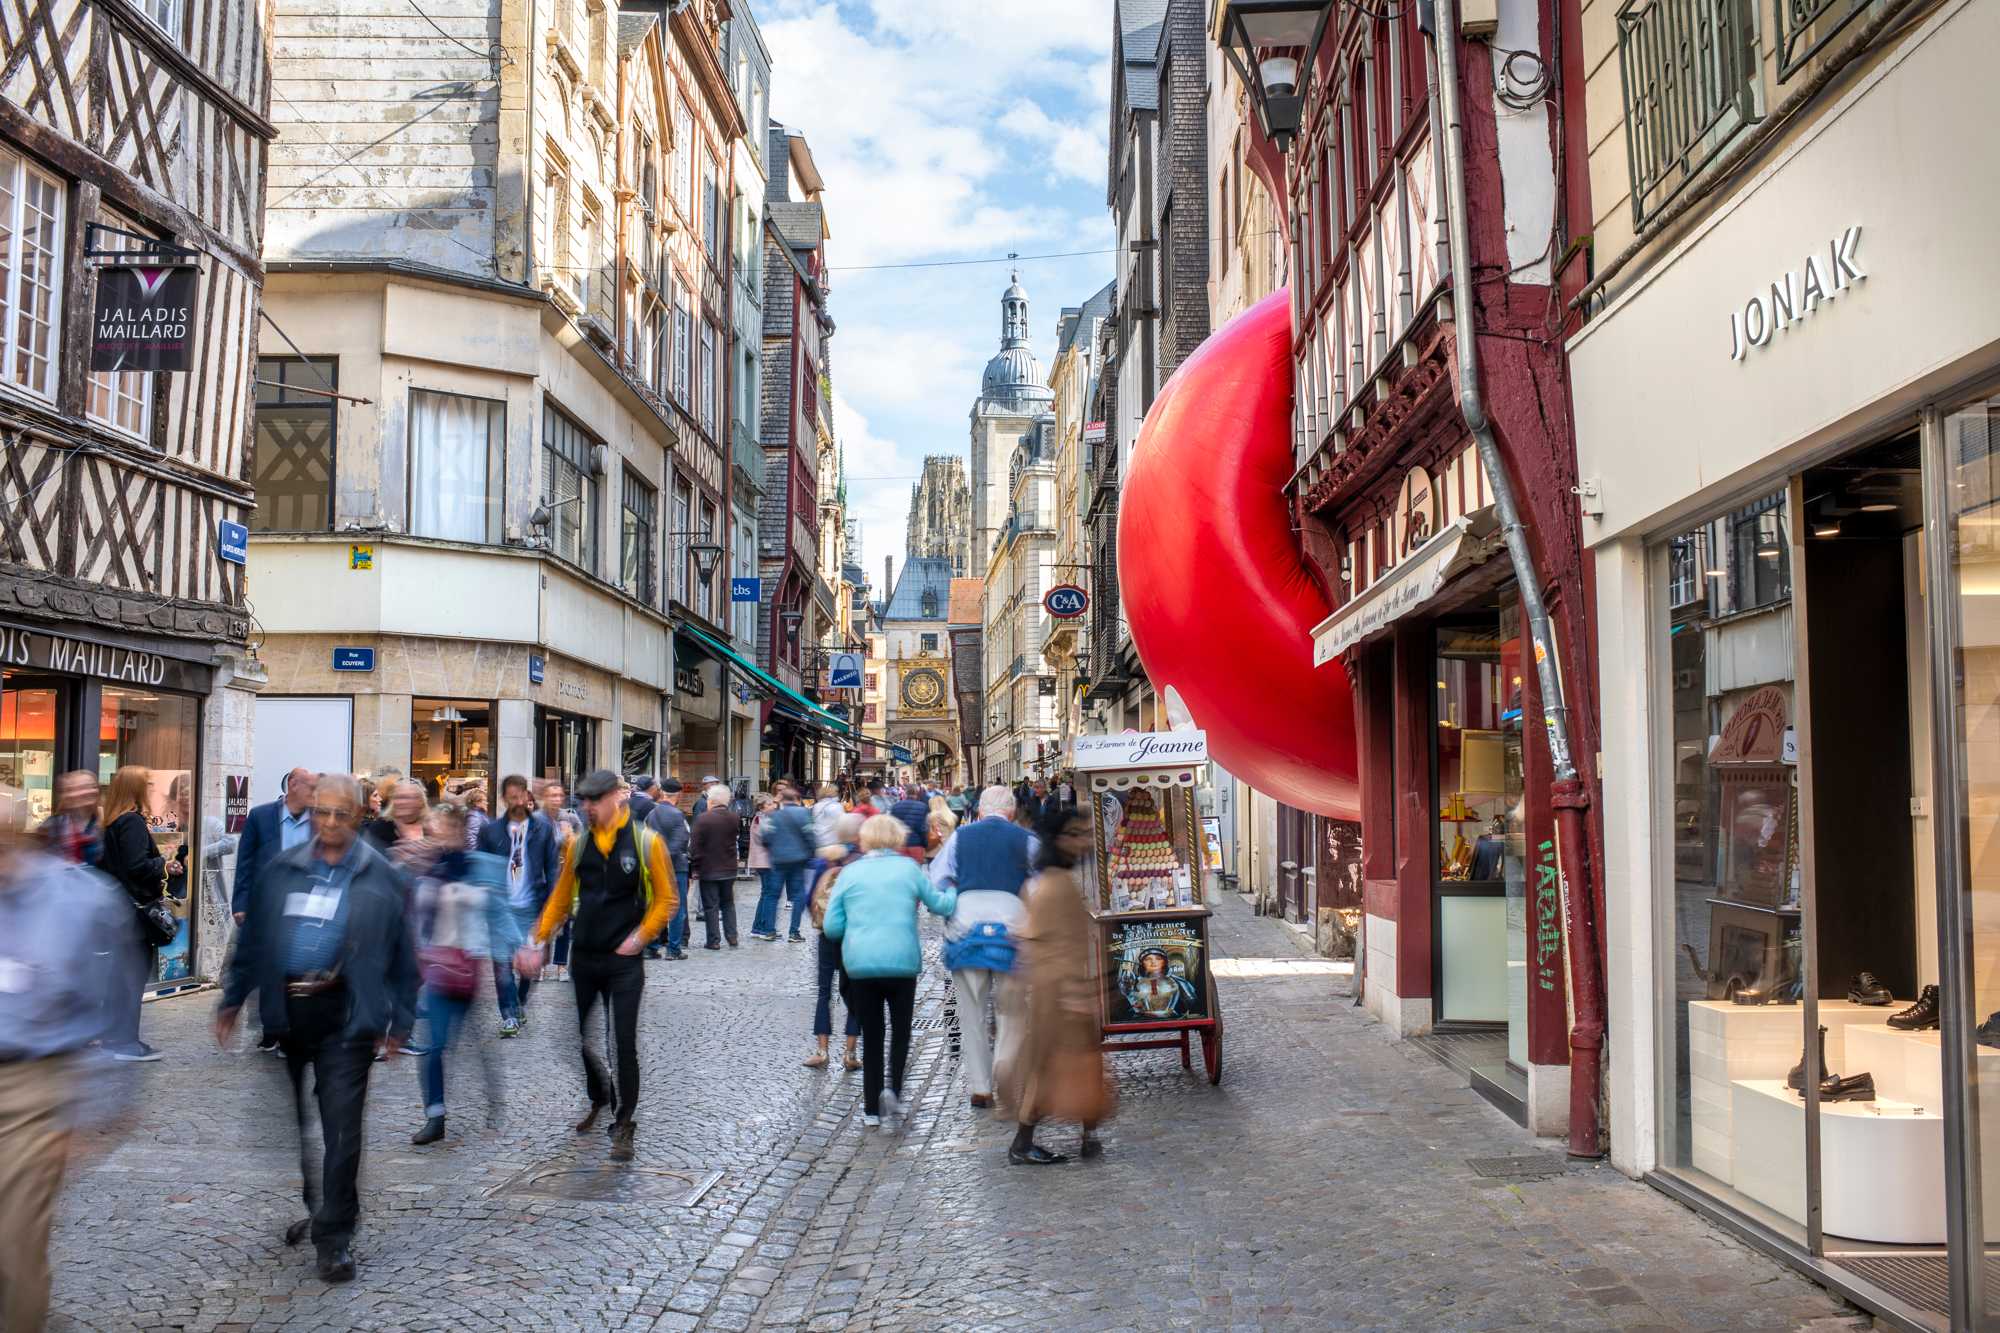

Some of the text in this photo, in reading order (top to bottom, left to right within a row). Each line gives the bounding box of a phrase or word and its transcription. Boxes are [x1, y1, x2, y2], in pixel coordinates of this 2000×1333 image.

[1730, 225, 1867, 362] JONAK
[100, 307, 188, 322] JALADIS
[99, 324, 187, 339] MAILLARD
[733, 584, 751, 595] tbs
[1051, 593, 1082, 609] C&A
[50, 636, 165, 685] MAILLARD
[1076, 736, 1204, 763] Les Larmes de Jeanne
[228, 798, 248, 806] JALADIS
[227, 806, 247, 816] MAILLARD
[1145, 921, 1187, 930] Larmes
[1112, 931, 1124, 940] de
